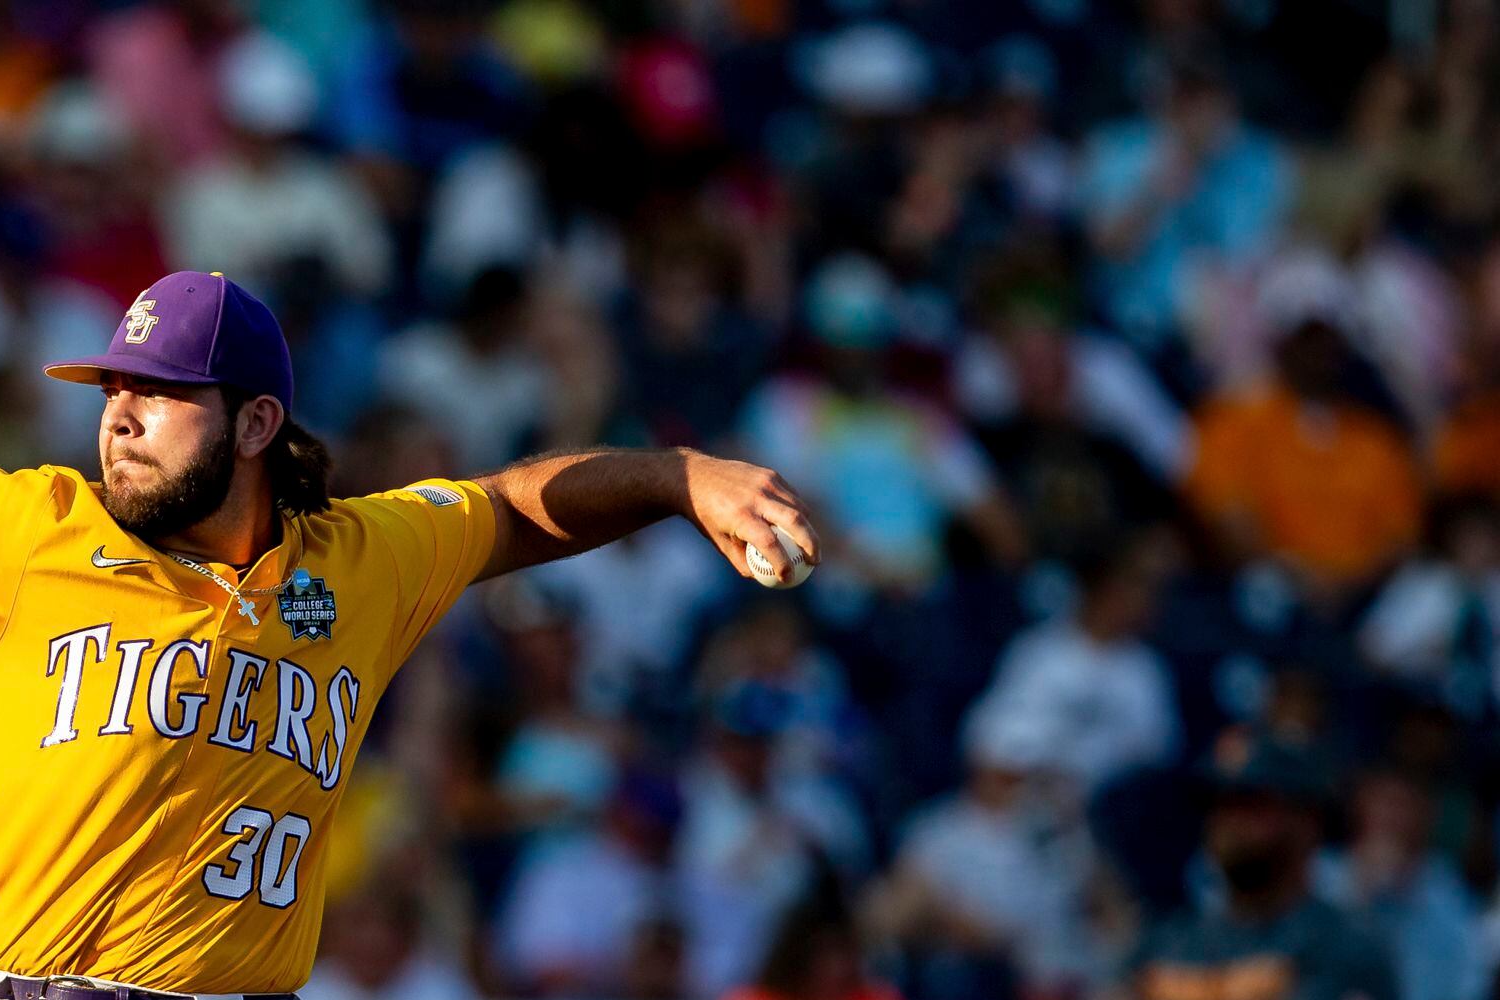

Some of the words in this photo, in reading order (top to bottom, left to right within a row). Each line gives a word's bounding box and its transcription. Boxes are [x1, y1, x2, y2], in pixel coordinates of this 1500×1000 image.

[125, 288, 160, 344] LSU
[283, 610, 310, 621] WORLD
[311, 610, 335, 621] SERIES
[293, 600, 324, 610] COLLEGE
[40, 622, 360, 791] TIGERS
[202, 804, 312, 910] 30
